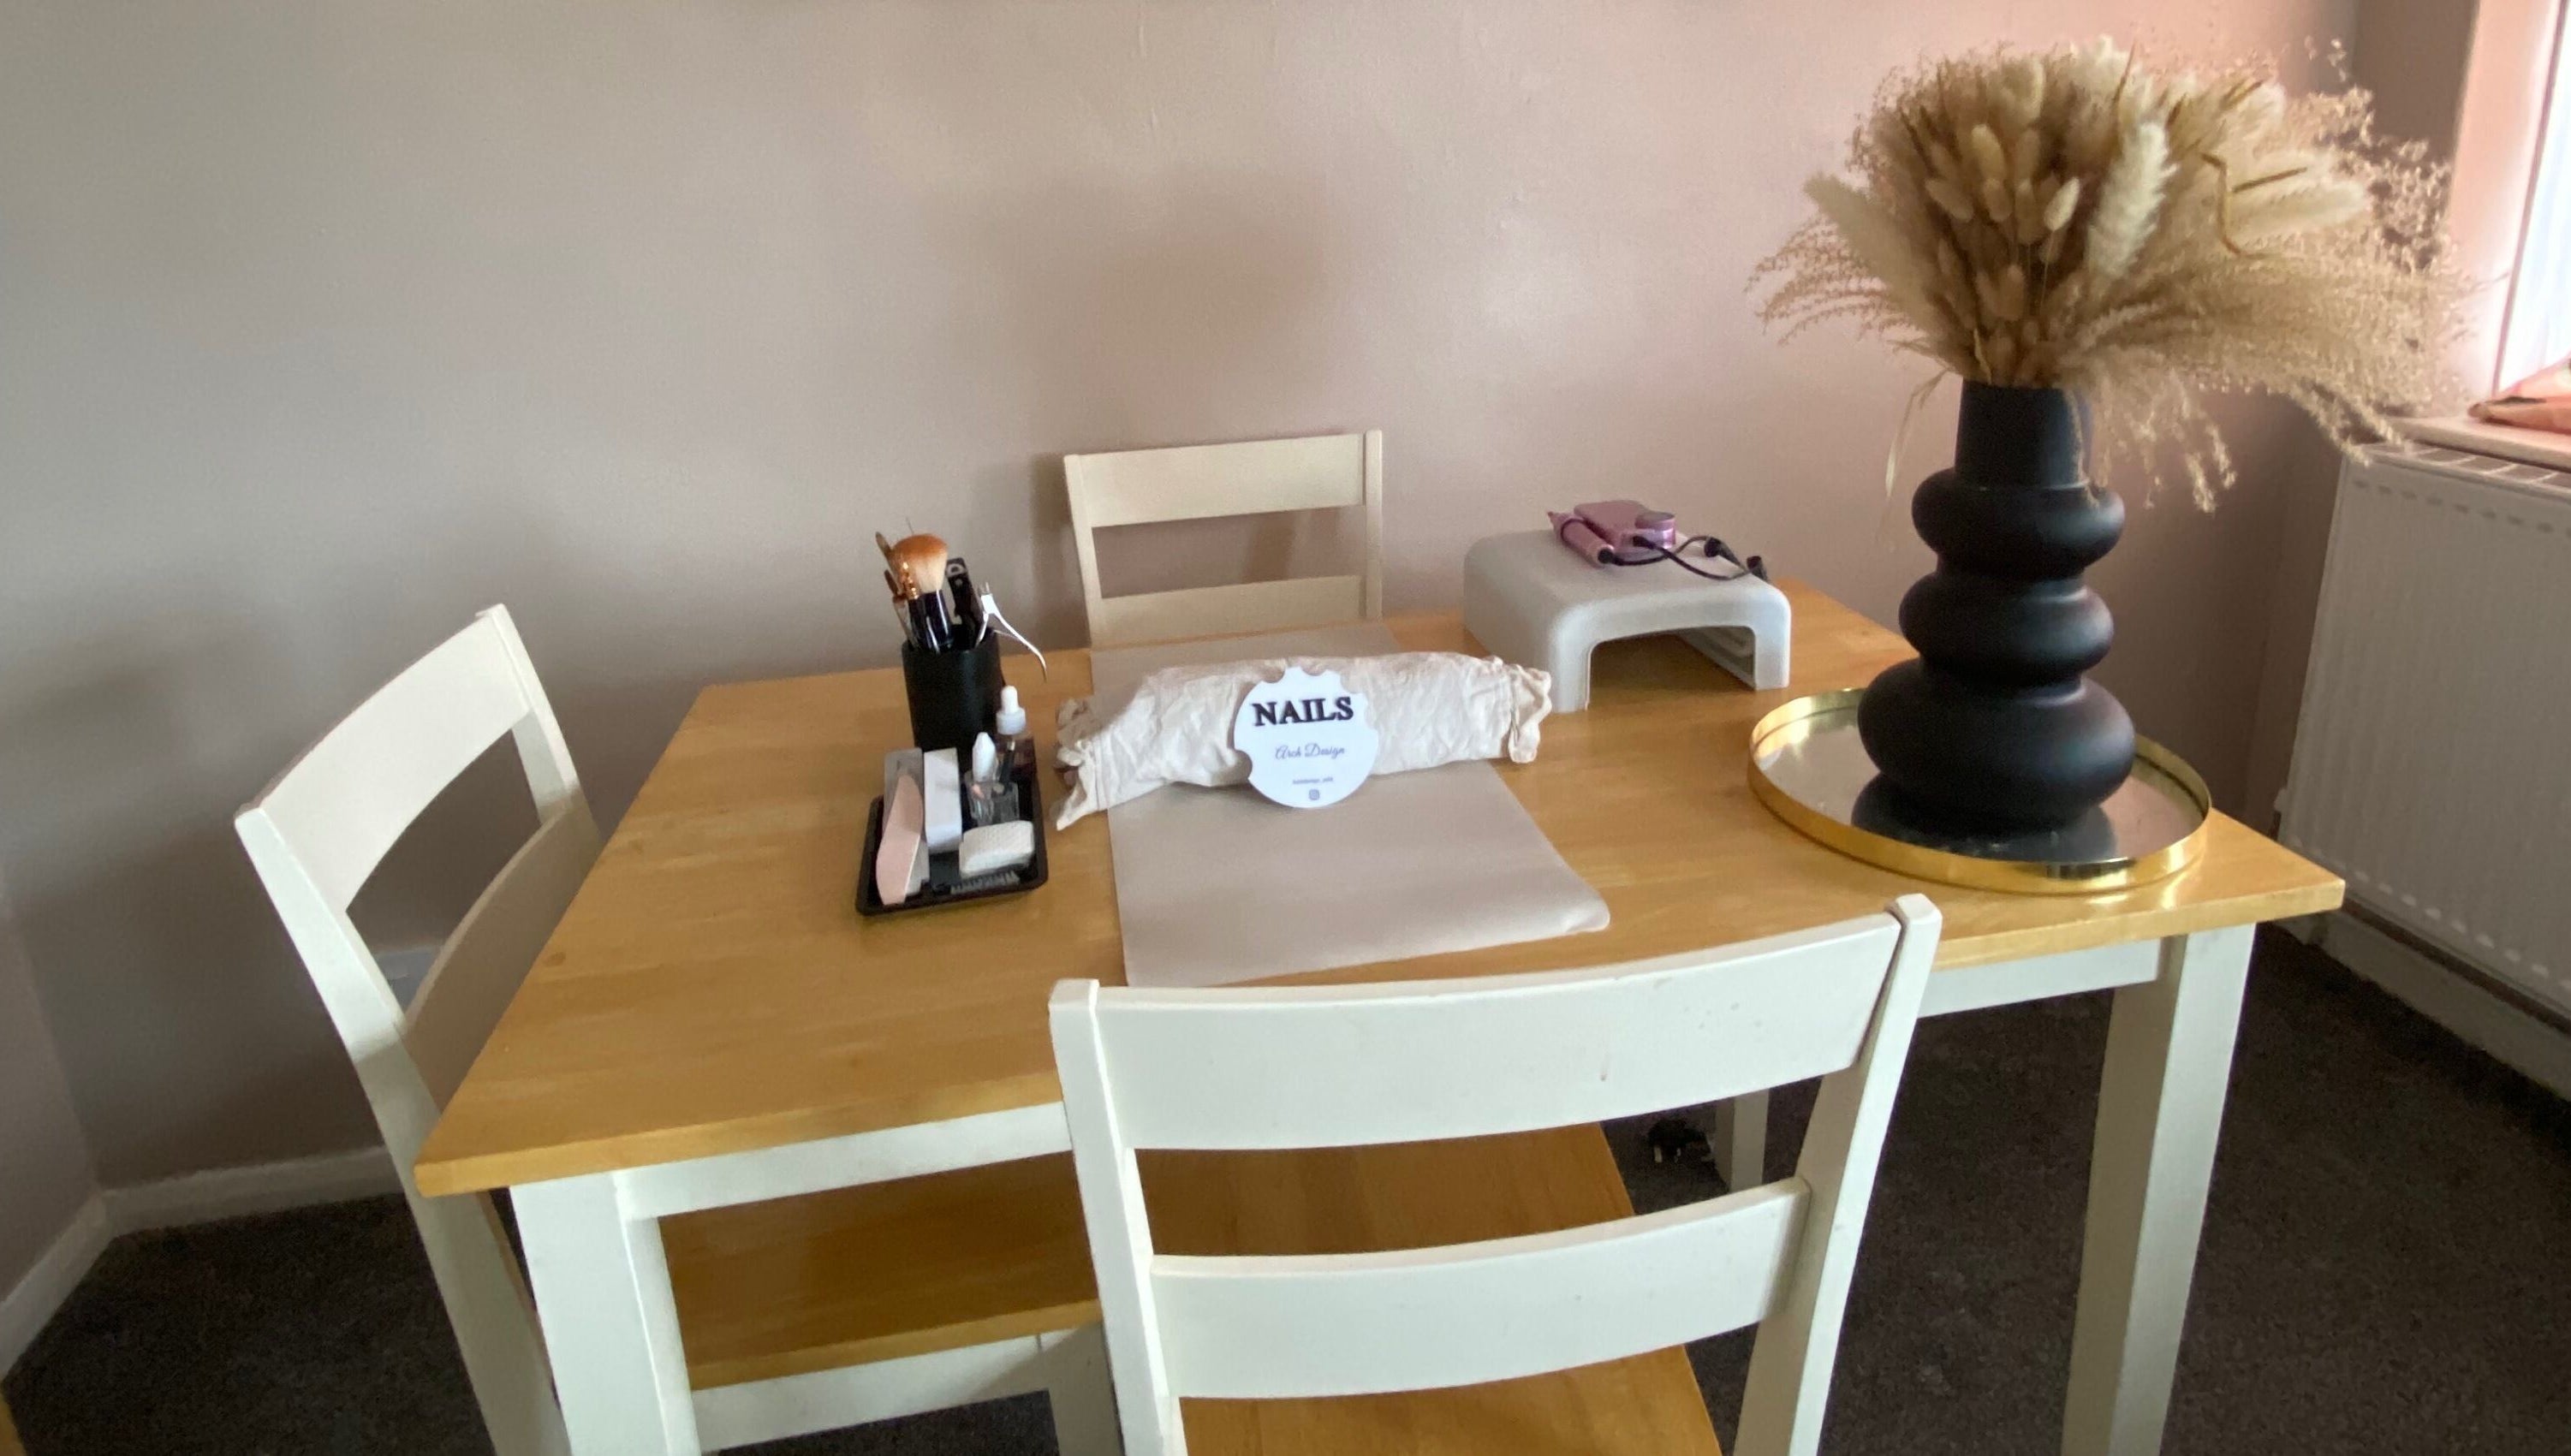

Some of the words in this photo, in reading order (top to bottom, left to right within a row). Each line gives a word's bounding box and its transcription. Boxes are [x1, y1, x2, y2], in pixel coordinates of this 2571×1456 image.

[1251, 696, 1354, 727] NAILS
[1275, 745, 1301, 760] Arch
[1305, 743, 1345, 759] Design
